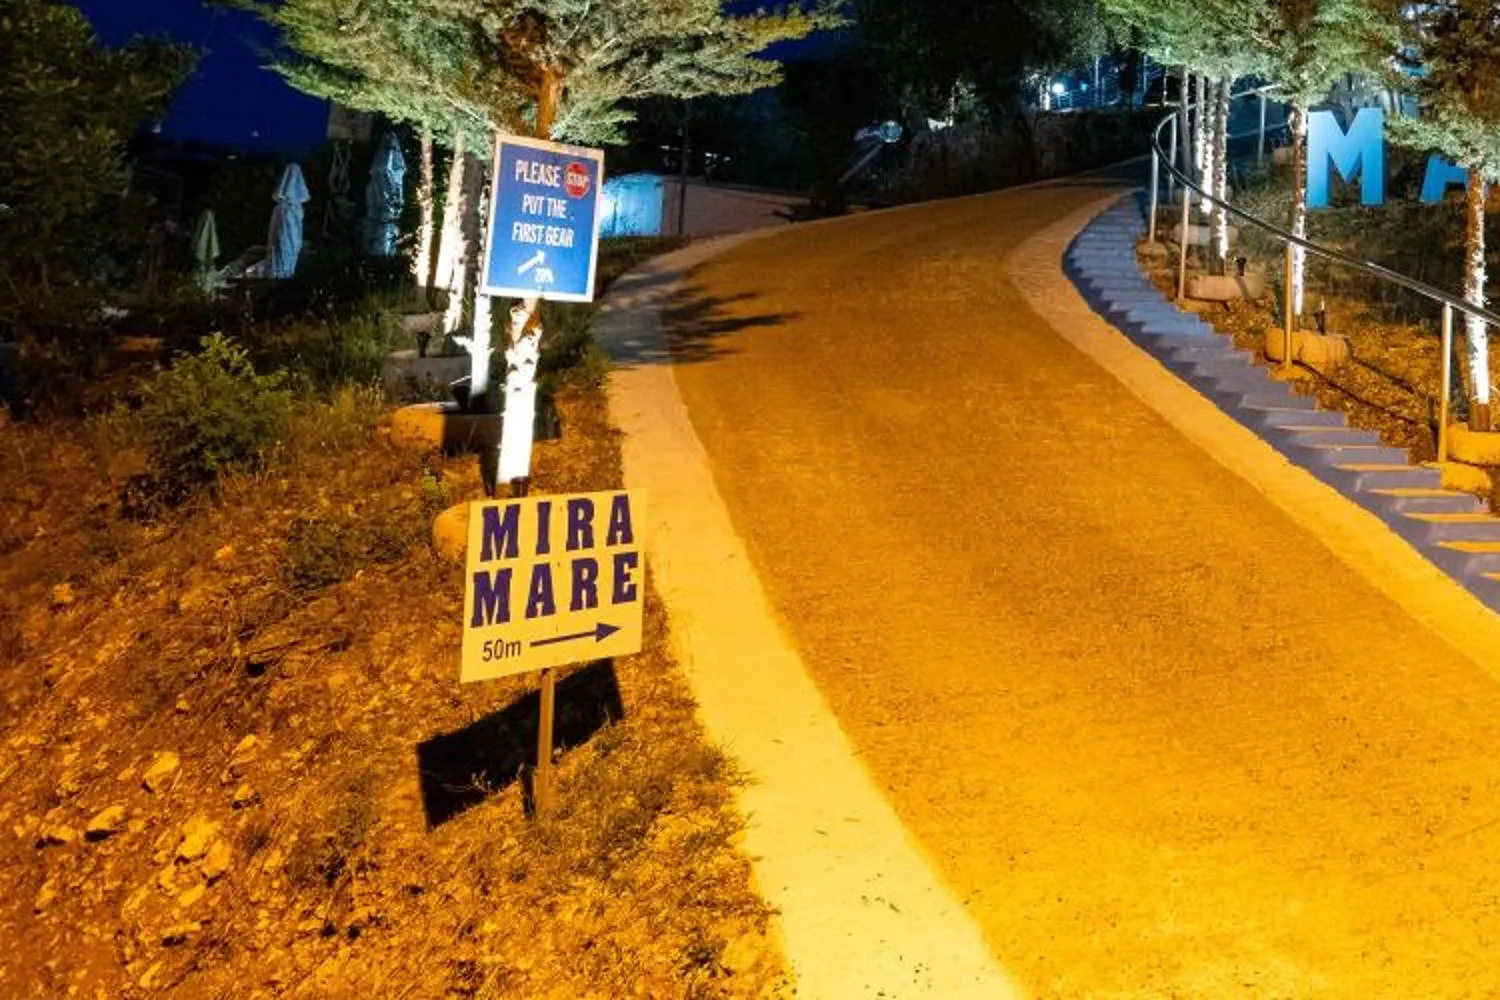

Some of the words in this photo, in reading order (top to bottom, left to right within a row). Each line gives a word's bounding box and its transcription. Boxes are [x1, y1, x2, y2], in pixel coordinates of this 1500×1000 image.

[515, 159, 561, 187] PLEASE
[522, 194, 545, 216] PUT
[547, 197, 568, 219] THE
[511, 221, 545, 245] FIRST
[545, 225, 575, 248] GEAR
[480, 494, 634, 562] MIRA
[470, 551, 639, 628] MARE
[482, 639, 522, 662] 50m
